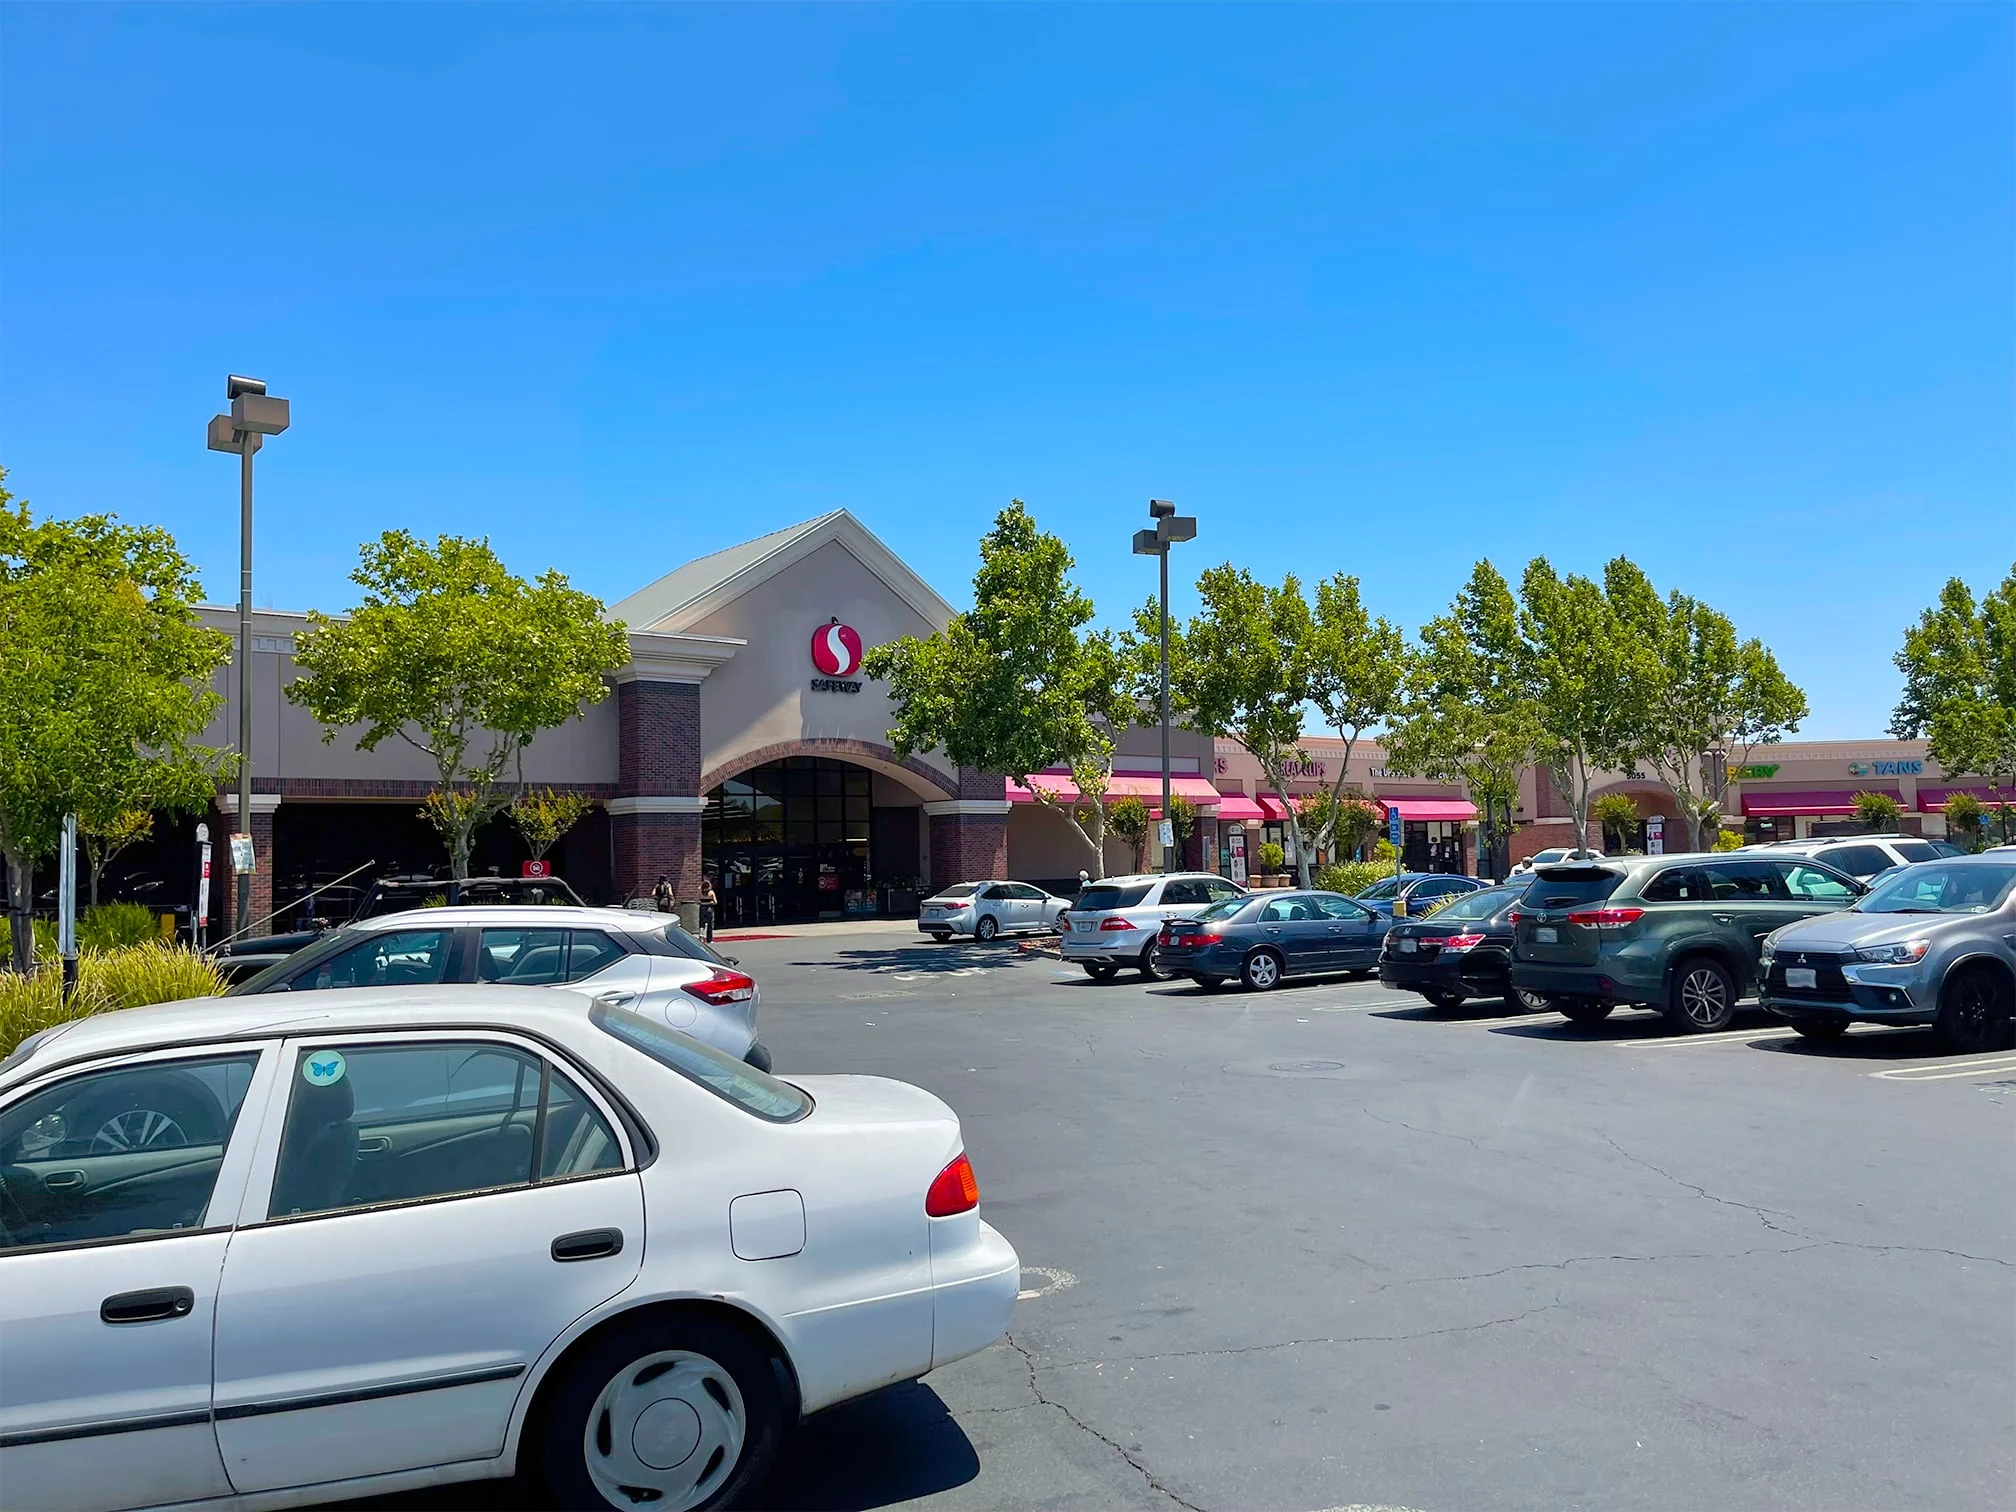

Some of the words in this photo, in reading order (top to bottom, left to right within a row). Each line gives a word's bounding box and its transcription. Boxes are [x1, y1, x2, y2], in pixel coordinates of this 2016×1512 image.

[811, 679, 863, 693] SAFEWAY
[1279, 760, 1303, 776] REAT
[1872, 761, 1923, 776] TANS
